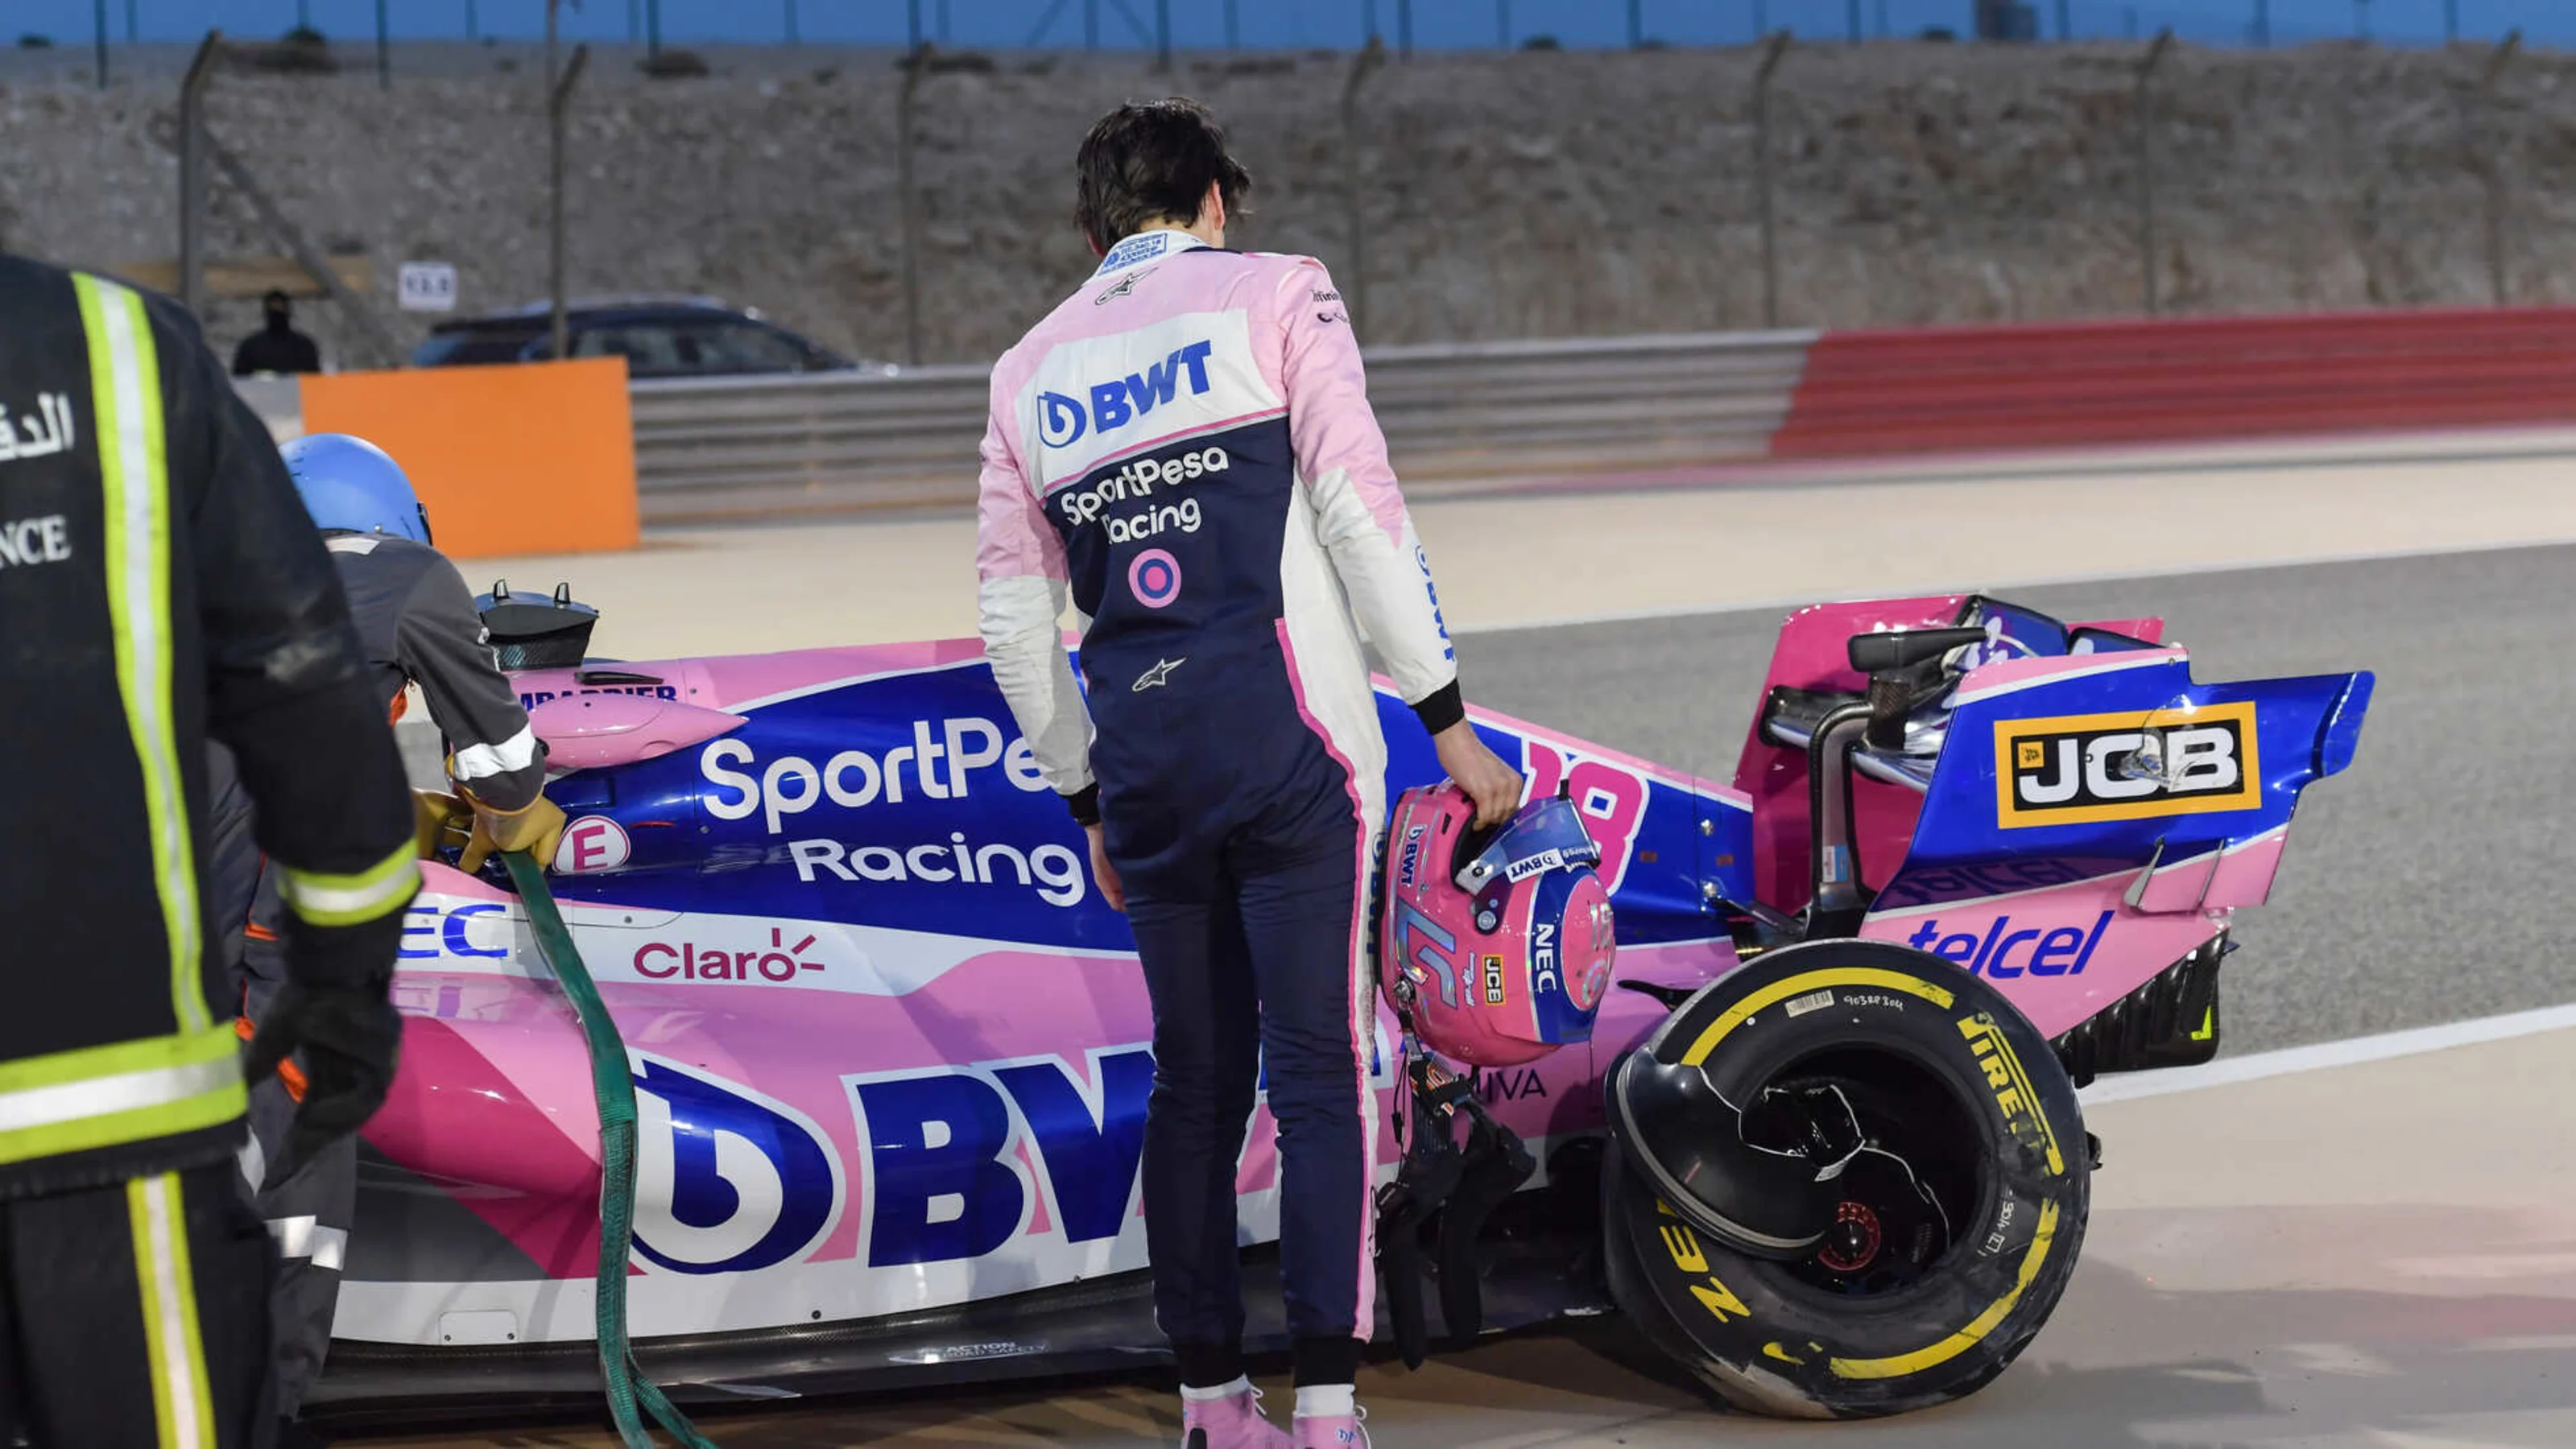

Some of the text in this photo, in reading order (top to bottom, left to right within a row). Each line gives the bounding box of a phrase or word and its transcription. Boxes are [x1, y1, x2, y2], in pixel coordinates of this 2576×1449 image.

[1090, 340, 1211, 434] BWT
[1061, 446, 1230, 526] SportPesa
[700, 716, 1049, 835] SportPe
[2019, 727, 2239, 803] JCB
[573, 825, 607, 872] E
[788, 832, 1085, 906] Racing
[1401, 843, 1418, 885] BWT
[1511, 855, 1543, 877] BWT
[397, 903, 508, 958] EC
[1535, 923, 1557, 993] NEC
[1908, 910, 2115, 979] telcel
[1485, 958, 1502, 1004] JCB
[1957, 1011, 2064, 1176] PIRE
